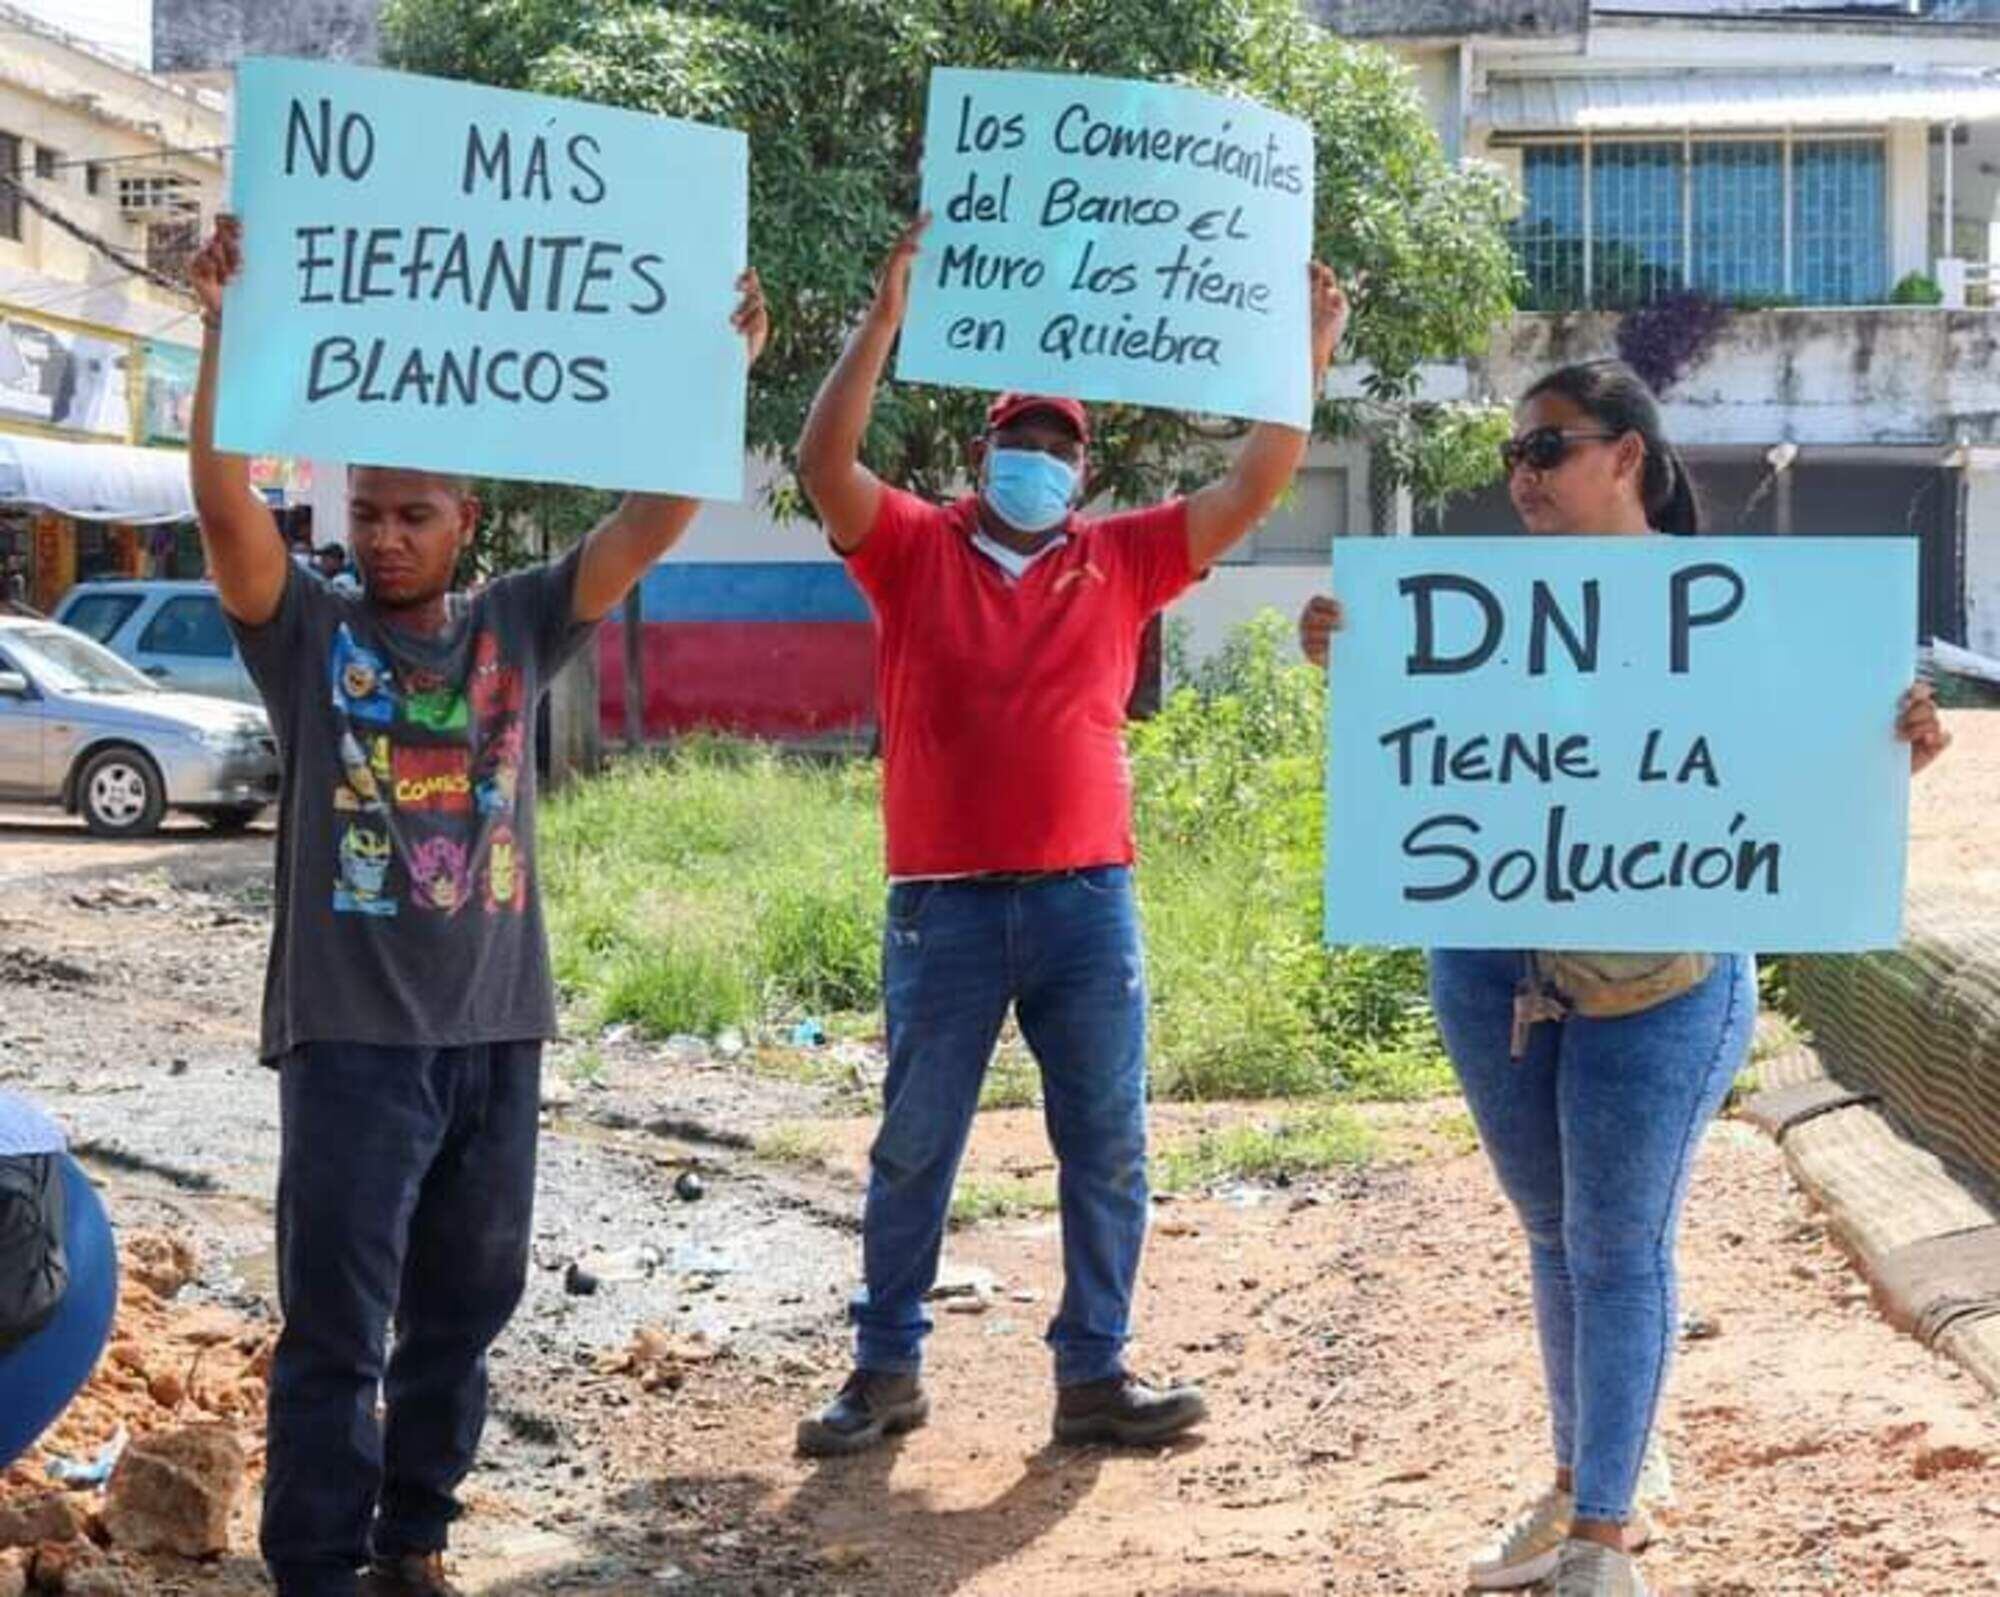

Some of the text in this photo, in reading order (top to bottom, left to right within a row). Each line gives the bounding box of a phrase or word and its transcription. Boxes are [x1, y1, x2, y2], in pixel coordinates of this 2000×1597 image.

[285, 98, 607, 204] NO MÁS
[1054, 103, 1302, 195] Comerciantes
[946, 171, 1251, 242] del Banco EL
[296, 224, 667, 315] ELEFANTES
[937, 240, 1275, 314] Muro Los tiene
[307, 335, 610, 408] BLANCOS
[946, 312, 1221, 366] en Quiebra
[1379, 717, 1721, 788] TIENE LA
[1402, 805, 1781, 902] Solución
